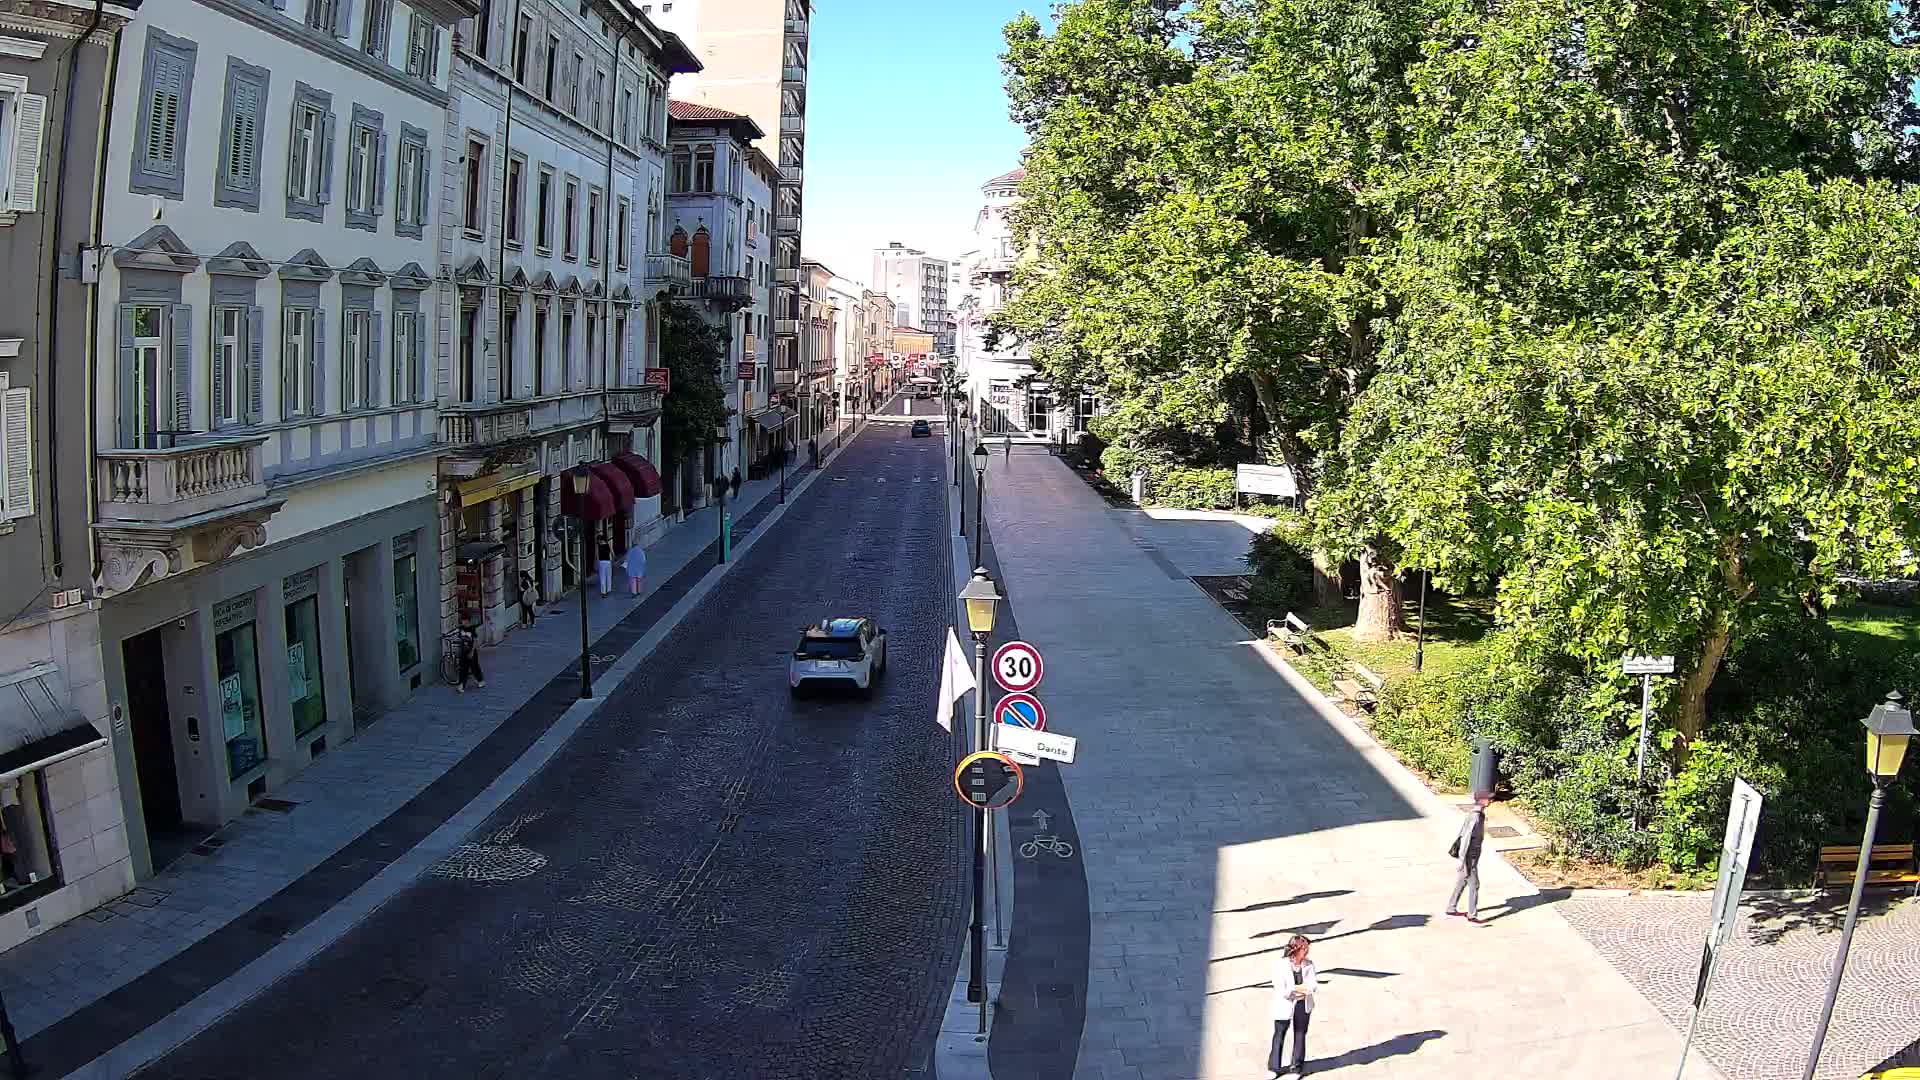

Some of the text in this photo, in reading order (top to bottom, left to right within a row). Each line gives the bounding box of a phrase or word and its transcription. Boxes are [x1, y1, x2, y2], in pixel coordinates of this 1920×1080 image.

[1005, 657, 1032, 678] 30
[221, 677, 239, 699] 130
[1037, 742, 1067, 756] Dante
